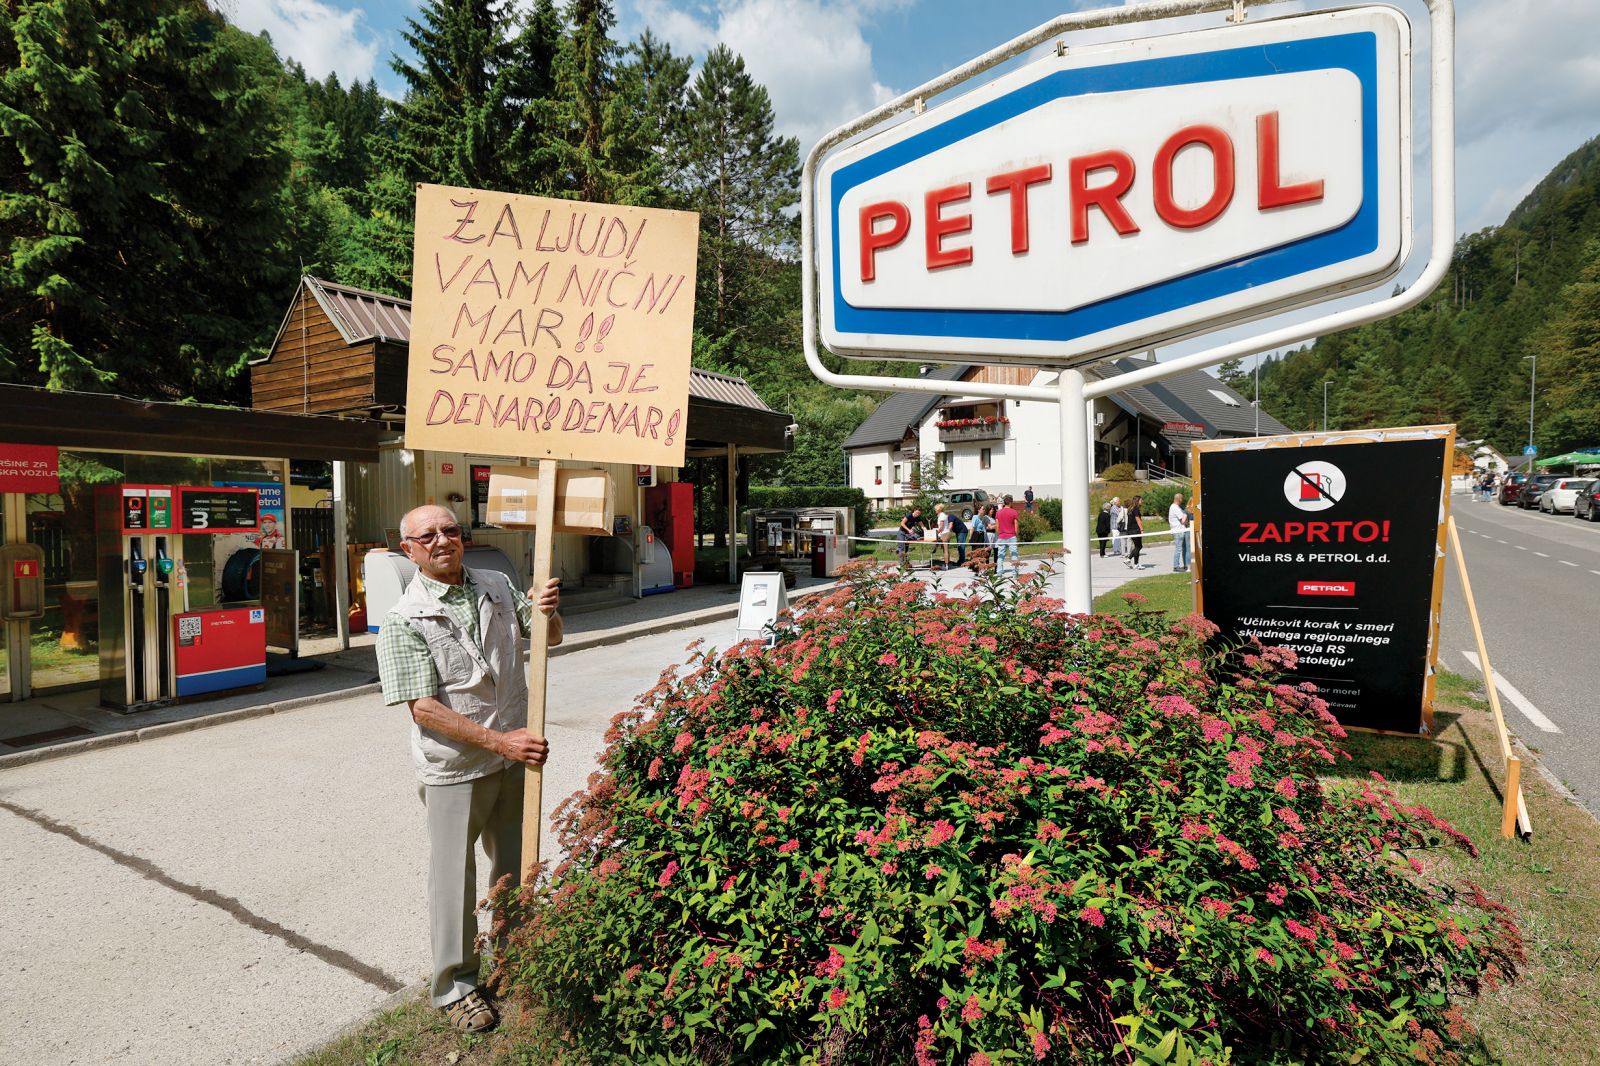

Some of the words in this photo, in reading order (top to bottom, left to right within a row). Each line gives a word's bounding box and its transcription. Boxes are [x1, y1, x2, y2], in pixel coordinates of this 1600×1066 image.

[859, 110, 1325, 283] PETROL
[443, 199, 523, 250] ZA
[536, 209, 647, 260] LJUDI
[436, 252, 549, 304] VAM
[430, 344, 537, 383] SAMO
[546, 355, 594, 394] DA
[603, 361, 659, 394] JE
[426, 389, 561, 434] DENAR!
[561, 398, 681, 446] DENAR!
[20, 469, 58, 477] VOZILA
[259, 497, 281, 506] etrol
[192, 511, 209, 529] 3
[1238, 520, 1391, 543] ZAPRTO!
[1238, 553, 1271, 563] Vlada
[1275, 553, 1292, 563] RS
[1296, 553, 1305, 563] &
[1308, 553, 1363, 563] PETROL
[1366, 553, 1391, 563] d.d.
[1304, 619, 1340, 630] korak
[1344, 622, 1353, 630] v
[1355, 622, 1395, 632] smeri
[1238, 629, 1301, 640] skladnega
[1304, 632, 1391, 645] regionalnega
[1326, 645, 1346, 654] RS
[1332, 688, 1361, 696] more!
